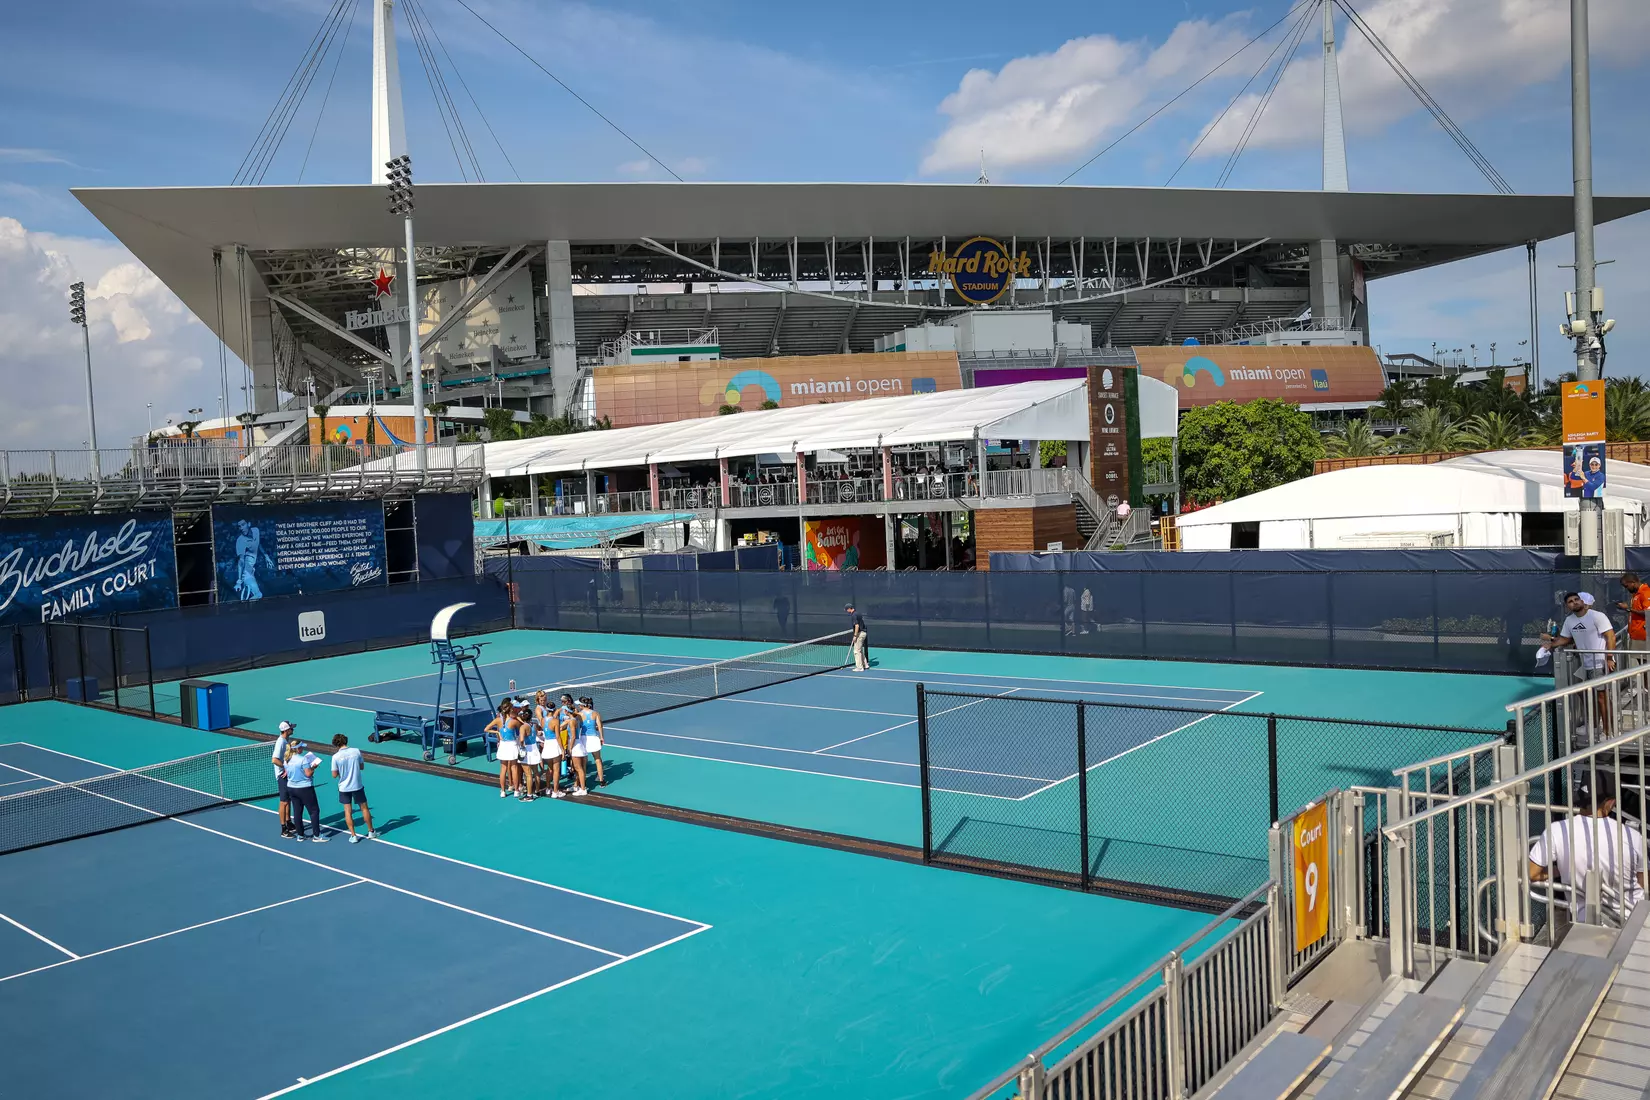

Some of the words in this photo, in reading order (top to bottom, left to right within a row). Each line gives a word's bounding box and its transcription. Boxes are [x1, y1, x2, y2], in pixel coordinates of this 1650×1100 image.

[928, 251, 982, 273] Hard
[982, 251, 1031, 278] Rock
[962, 282, 998, 290] STADIUM
[498, 303, 526, 314] Heineken
[473, 327, 499, 337] Heineken
[501, 343, 528, 353] Heineken
[449, 351, 475, 360] Heineken
[1229, 365, 1273, 380] miami
[1275, 367, 1306, 383] open
[790, 376, 851, 395] miami
[856, 377, 902, 396] open
[1313, 378, 1328, 388] Itaú
[341, 531, 364, 539] EVERYONE
[277, 549, 311, 557] MERCHANDISE,
[277, 555, 315, 564] ENTERTAINMENT
[315, 552, 344, 560] EXPERIENCE
[0, 518, 152, 610] Buchholz
[41, 583, 96, 622] FAMILY
[102, 558, 157, 596] COURT
[301, 624, 324, 637] Itaú
[1301, 822, 1322, 847] Court
[1305, 861, 1318, 913] 9
